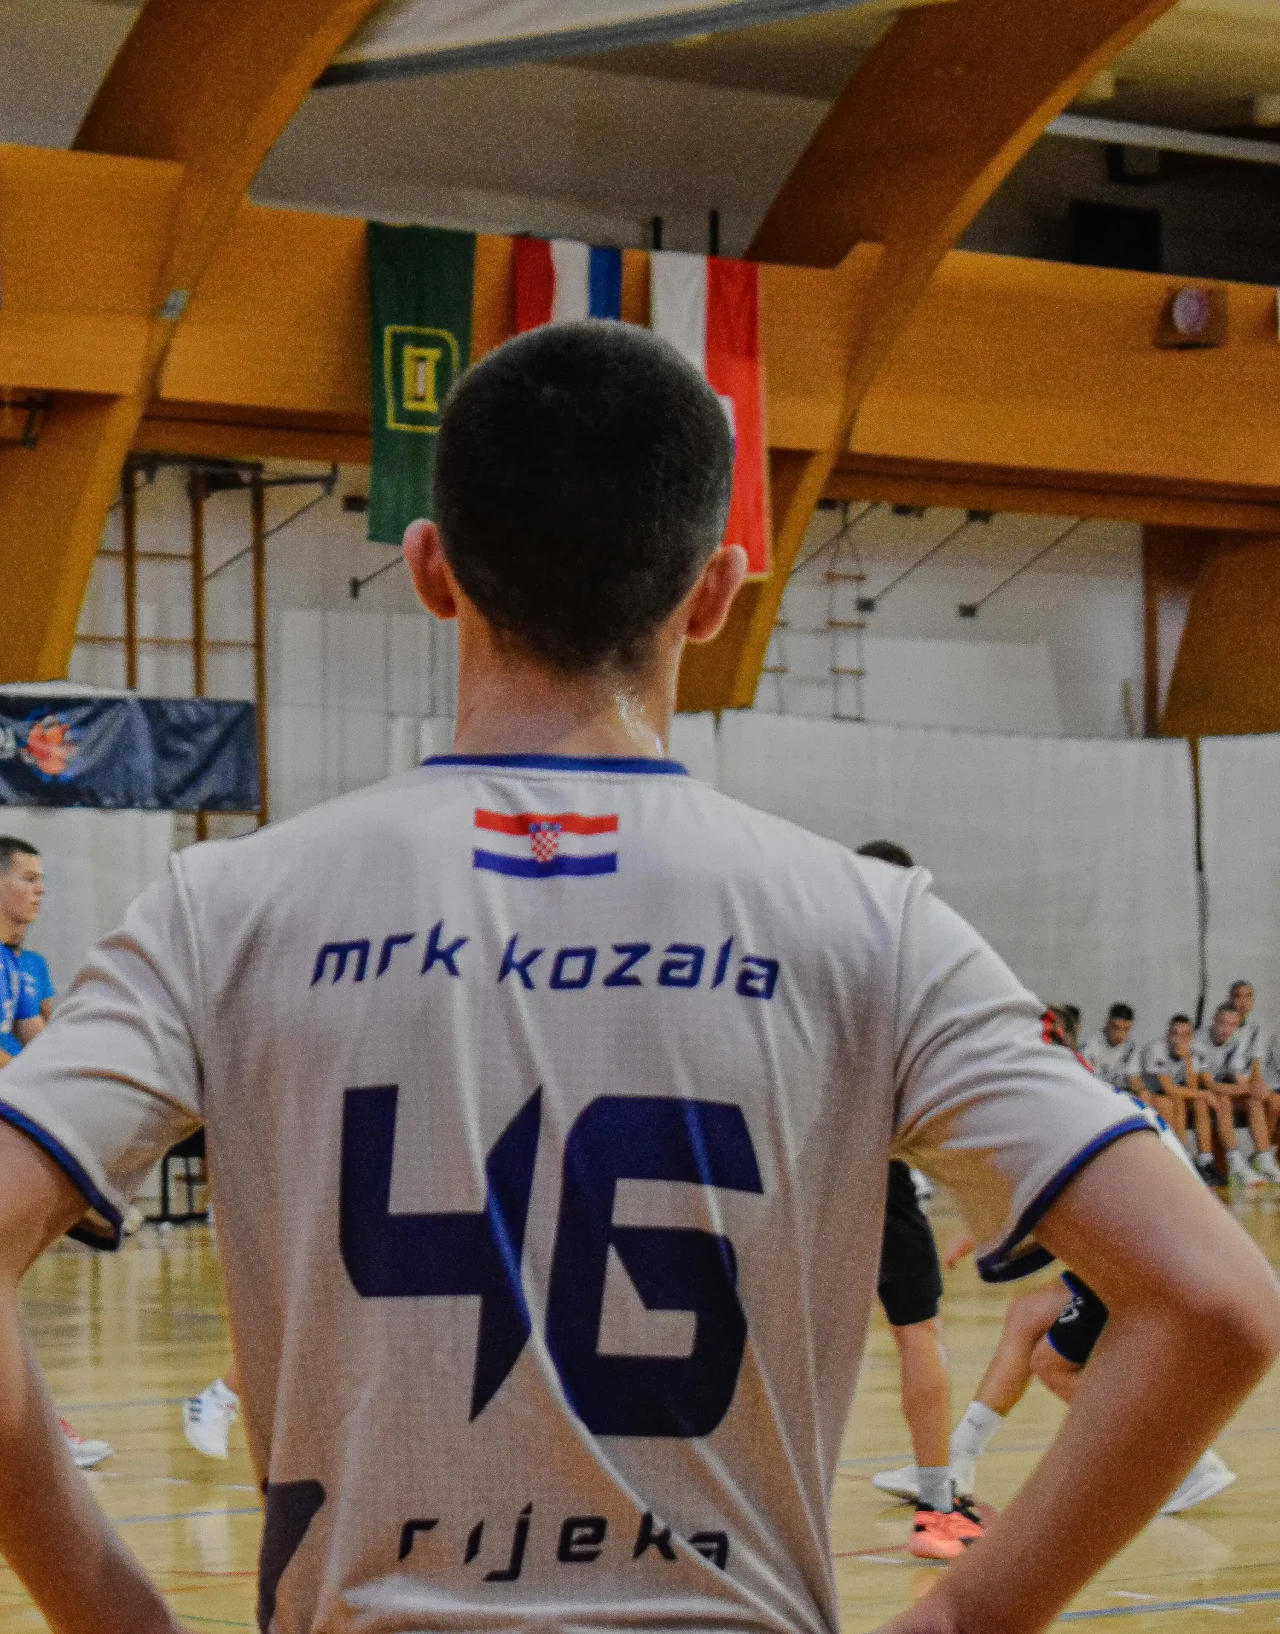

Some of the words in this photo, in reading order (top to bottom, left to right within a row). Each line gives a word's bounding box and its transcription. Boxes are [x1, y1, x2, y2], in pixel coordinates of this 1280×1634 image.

[310, 919, 469, 988] mrk
[498, 933, 780, 1000] kozala
[339, 1083, 764, 1438] 46
[398, 1501, 730, 1582] rijeka
